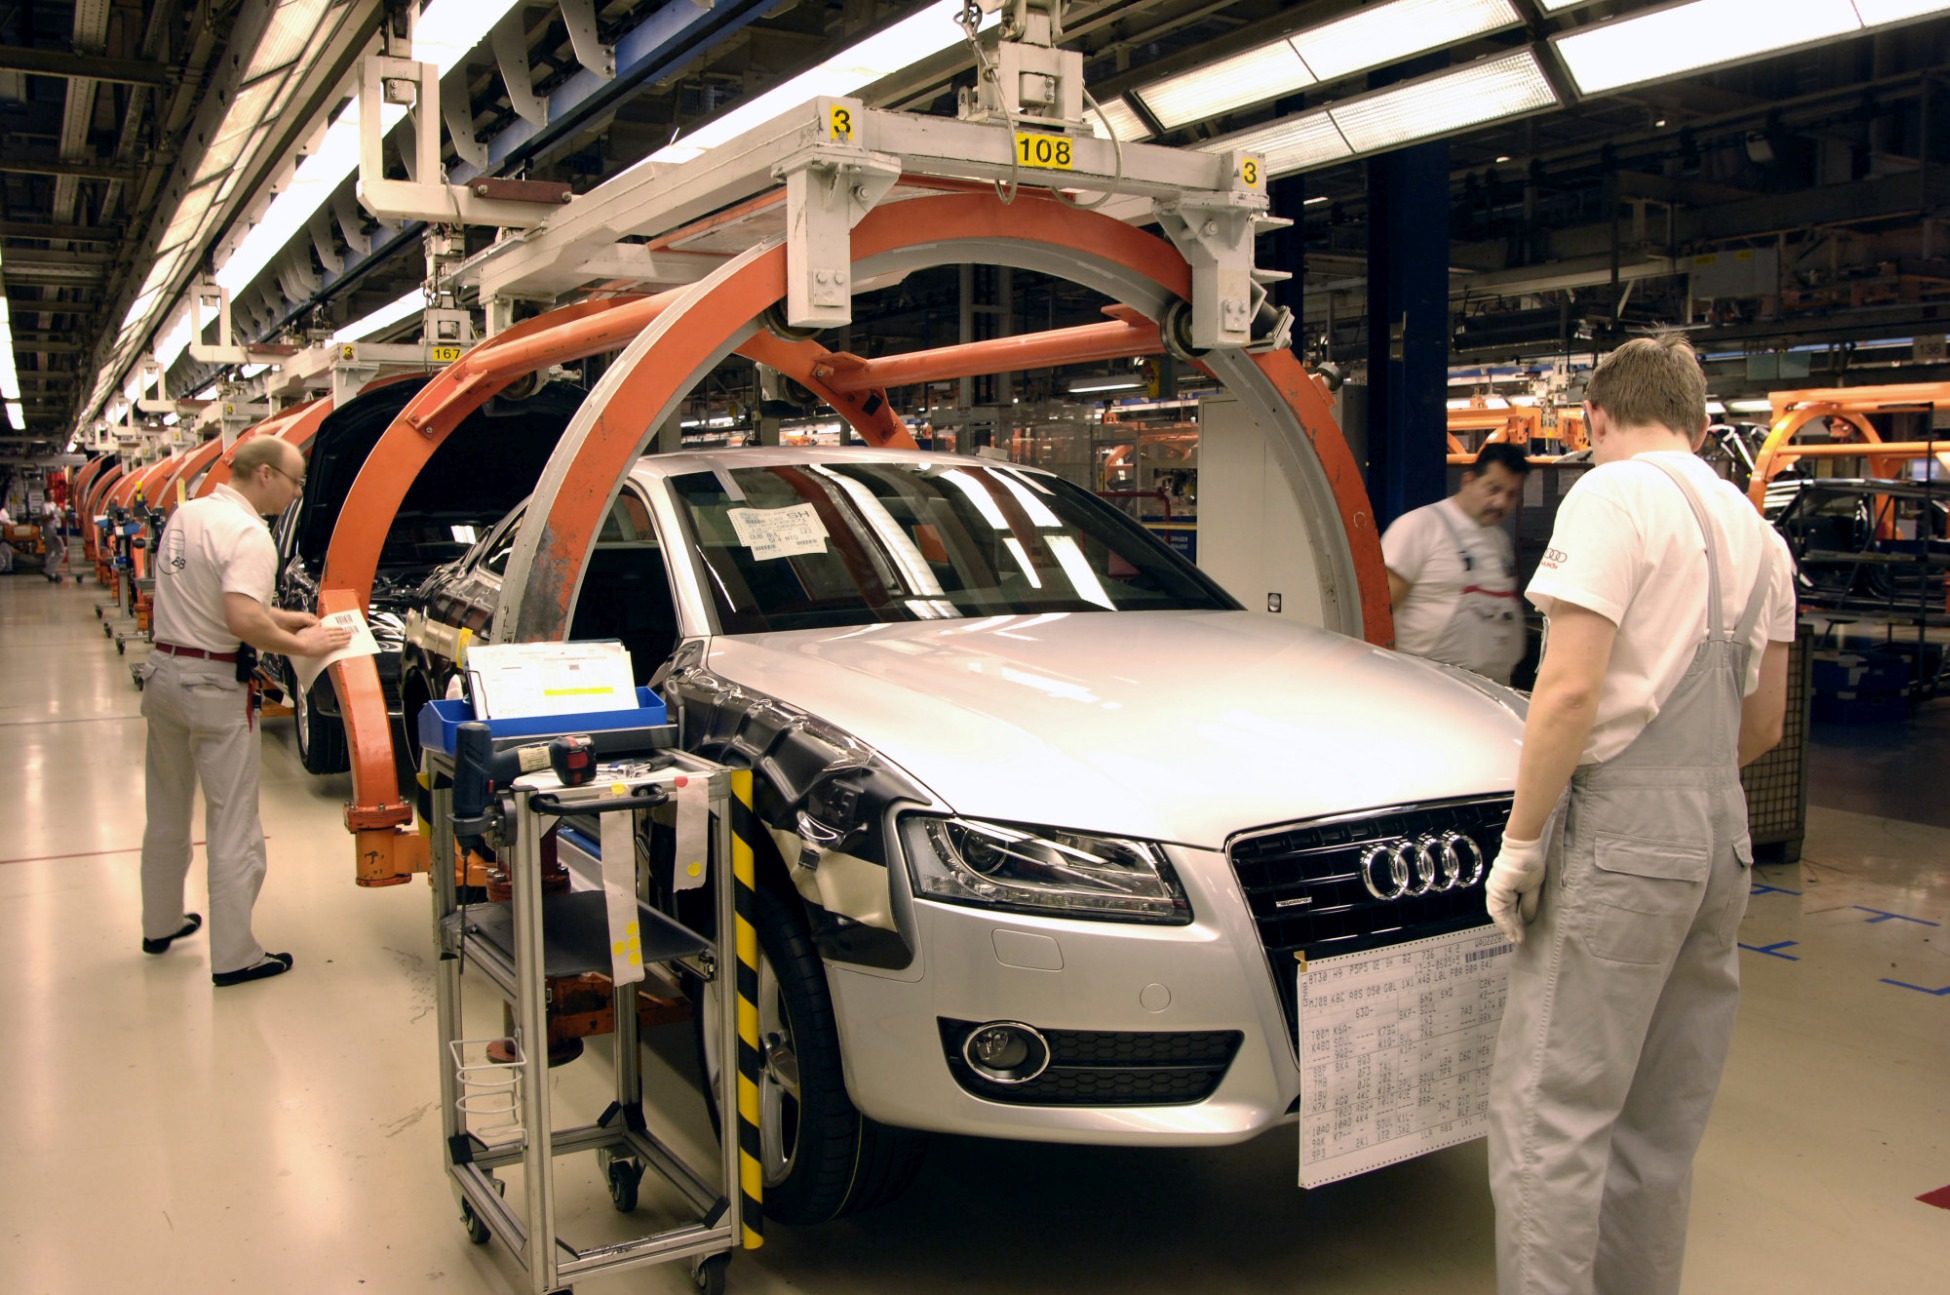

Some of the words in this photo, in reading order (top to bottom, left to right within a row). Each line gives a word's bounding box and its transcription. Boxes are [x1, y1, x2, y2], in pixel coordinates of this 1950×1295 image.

[834, 109, 851, 136] 3
[1018, 138, 1071, 165] 108
[1243, 162, 1257, 185] 3
[434, 348, 461, 359] 167
[787, 510, 810, 519] SH
